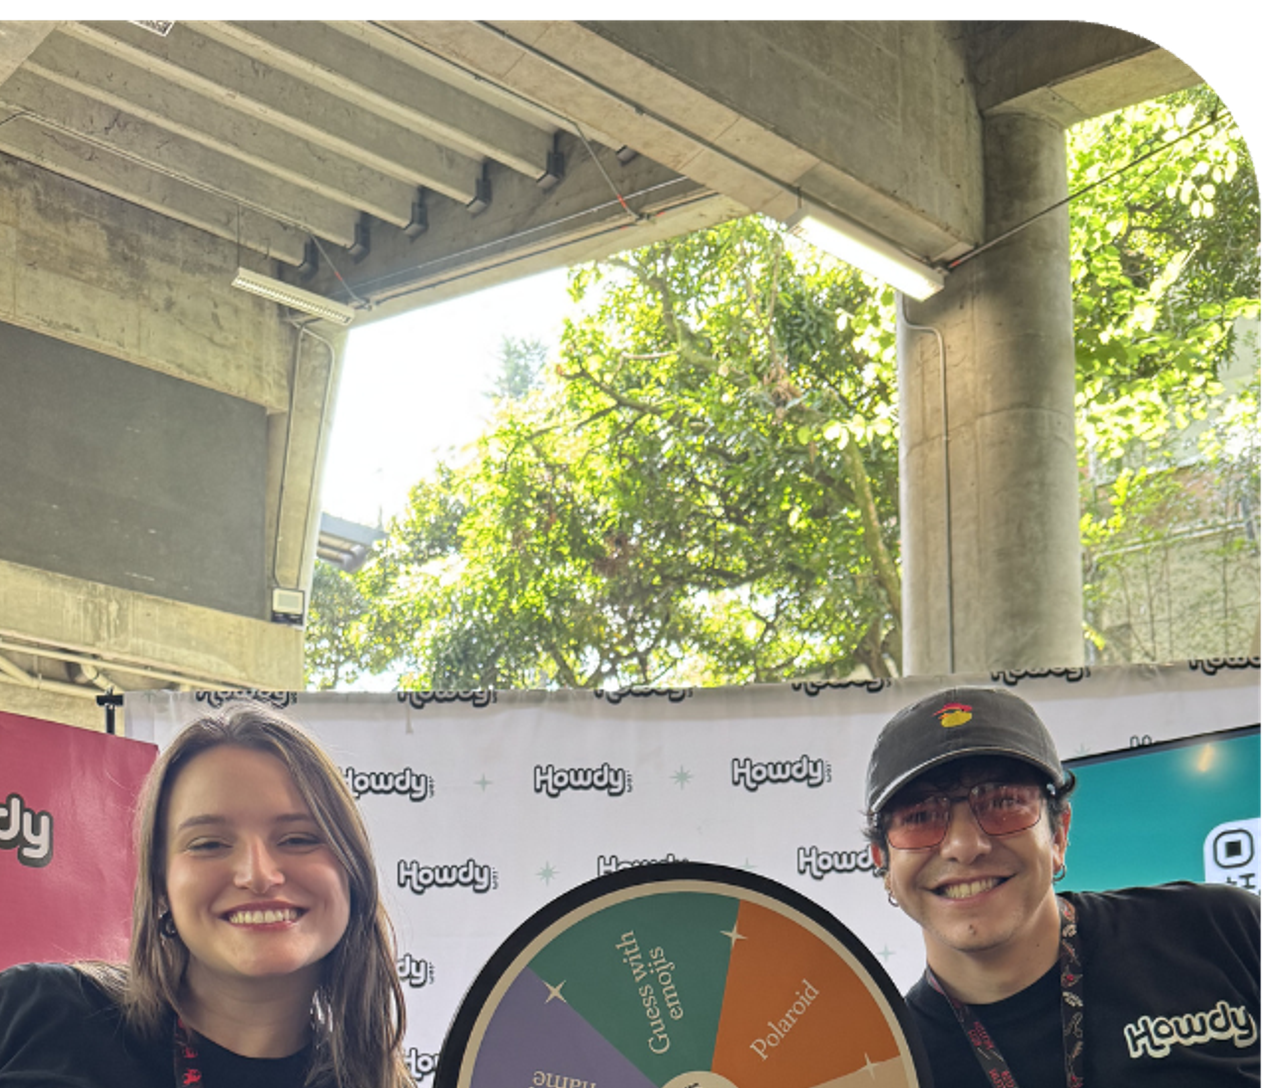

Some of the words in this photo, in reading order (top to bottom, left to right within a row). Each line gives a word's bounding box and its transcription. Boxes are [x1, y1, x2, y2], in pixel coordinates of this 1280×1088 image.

[534, 762, 627, 798] Howdy
[732, 755, 825, 791] Howdy
[397, 858, 491, 895] Howdy
[798, 845, 875, 880] Howd
[615, 930, 648, 983] with
[648, 946, 684, 1021] emojis
[638, 983, 671, 1055] Guess
[749, 978, 820, 1061] Polaroid
[1124, 1000, 1258, 1059] Howdy
